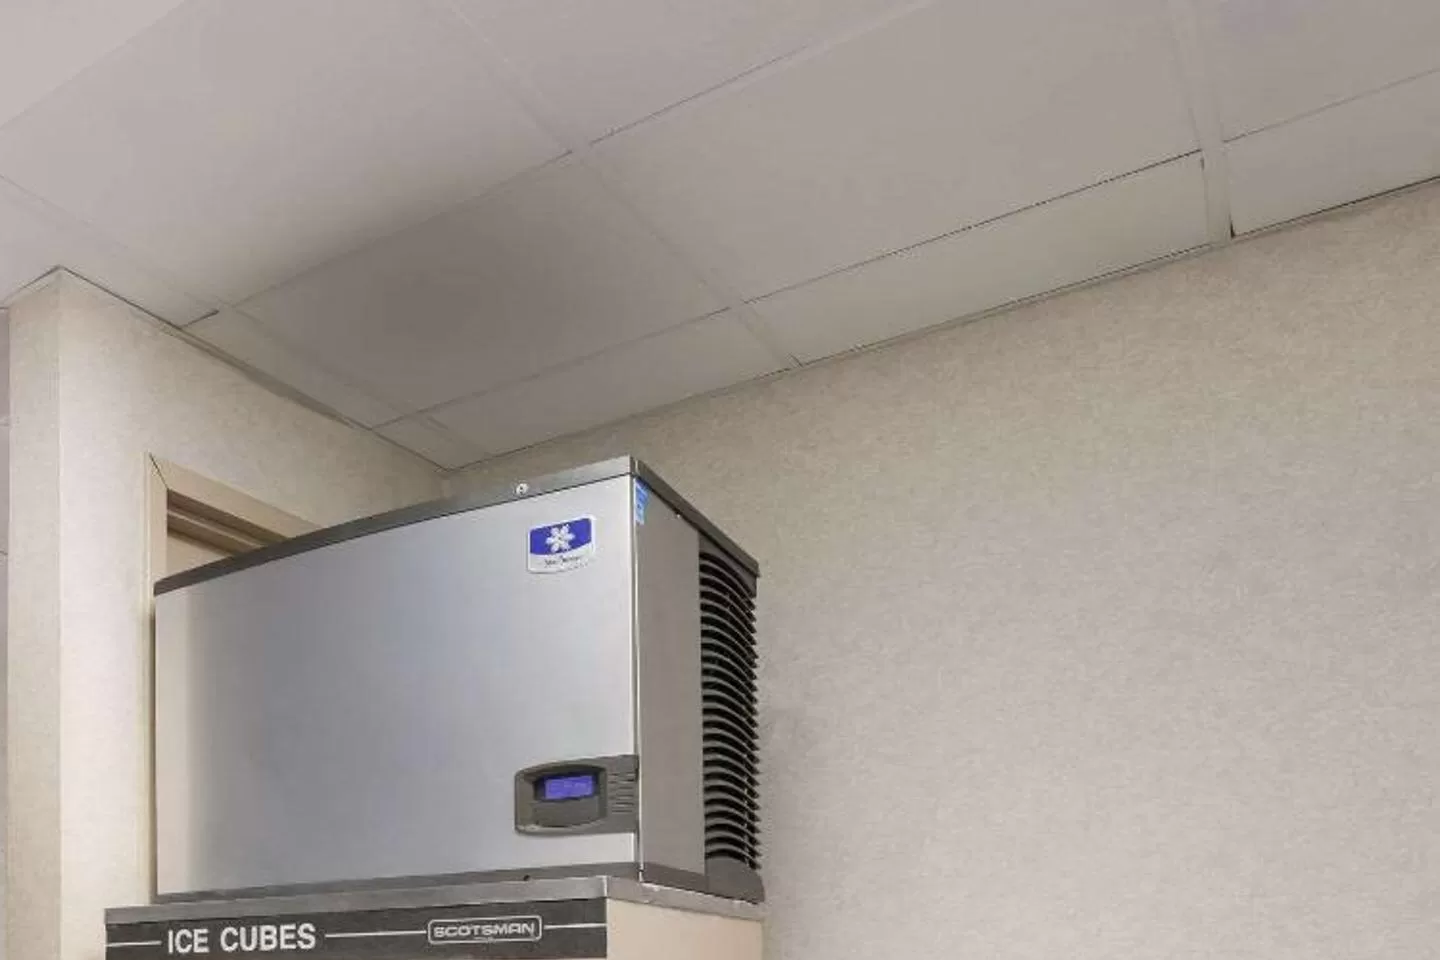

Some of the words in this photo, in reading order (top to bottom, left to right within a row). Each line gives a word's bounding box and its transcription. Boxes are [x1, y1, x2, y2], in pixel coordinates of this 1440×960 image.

[167, 928, 210, 954] ICE
[220, 922, 316, 952] CUBES
[433, 922, 535, 938] SCOTSMAN
